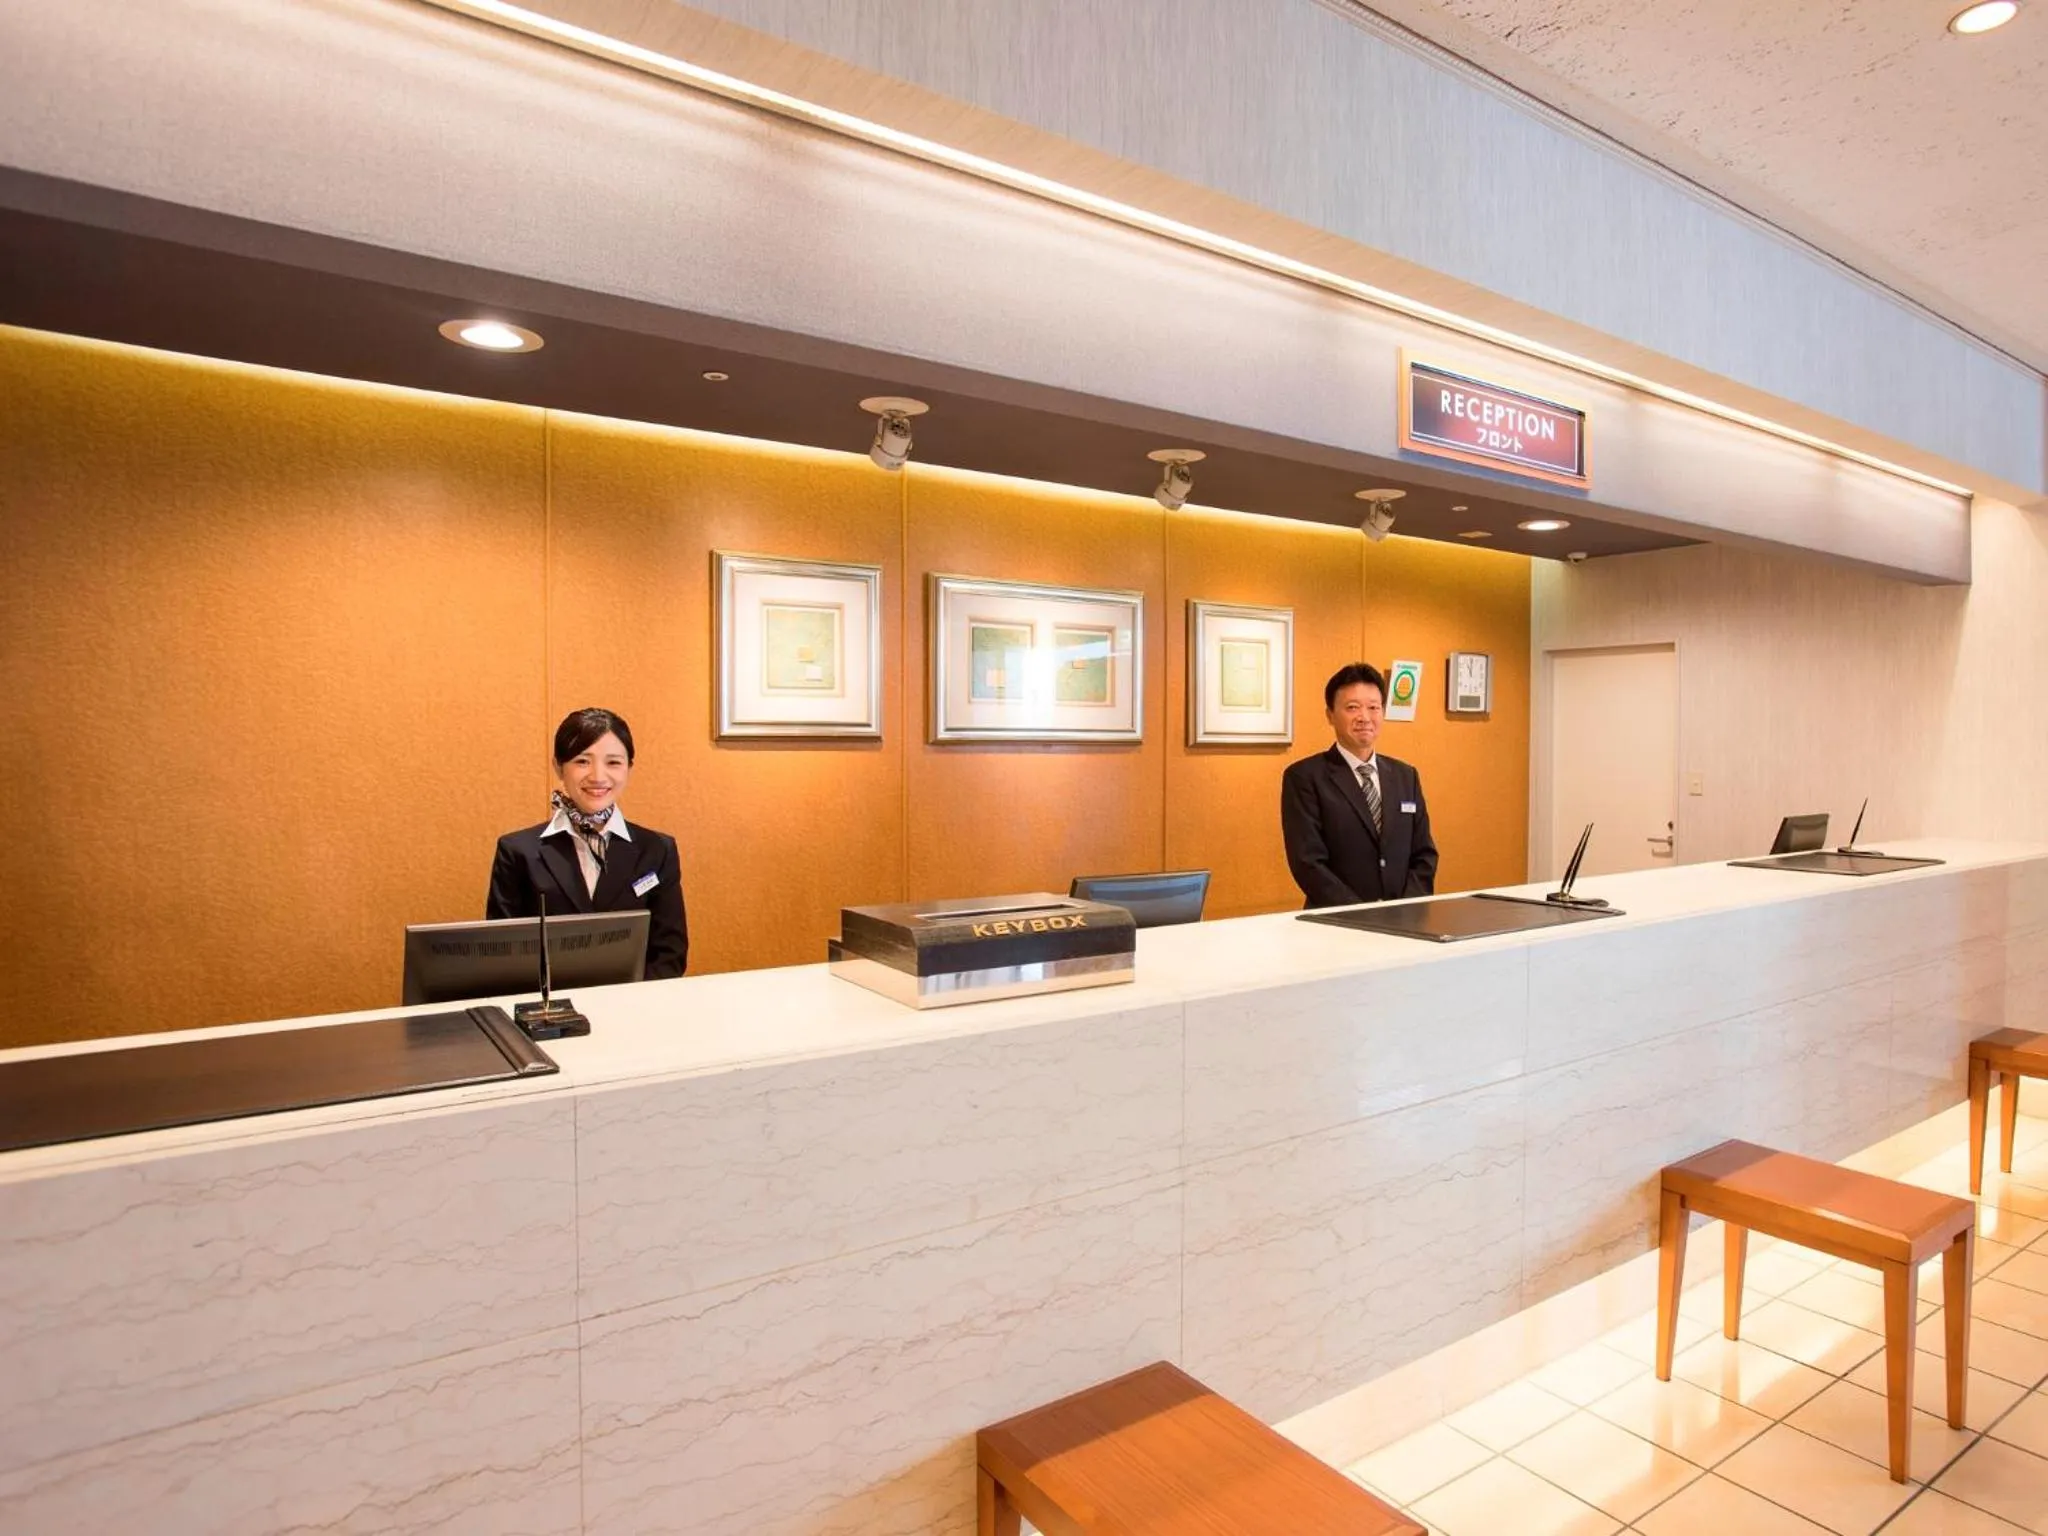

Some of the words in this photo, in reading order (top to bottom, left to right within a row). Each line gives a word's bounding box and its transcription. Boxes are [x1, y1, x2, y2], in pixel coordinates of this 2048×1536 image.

[1440, 389, 1555, 442] RECEPTION
[1475, 427, 1523, 453] フロント
[972, 914, 1088, 938] KEYBOX
